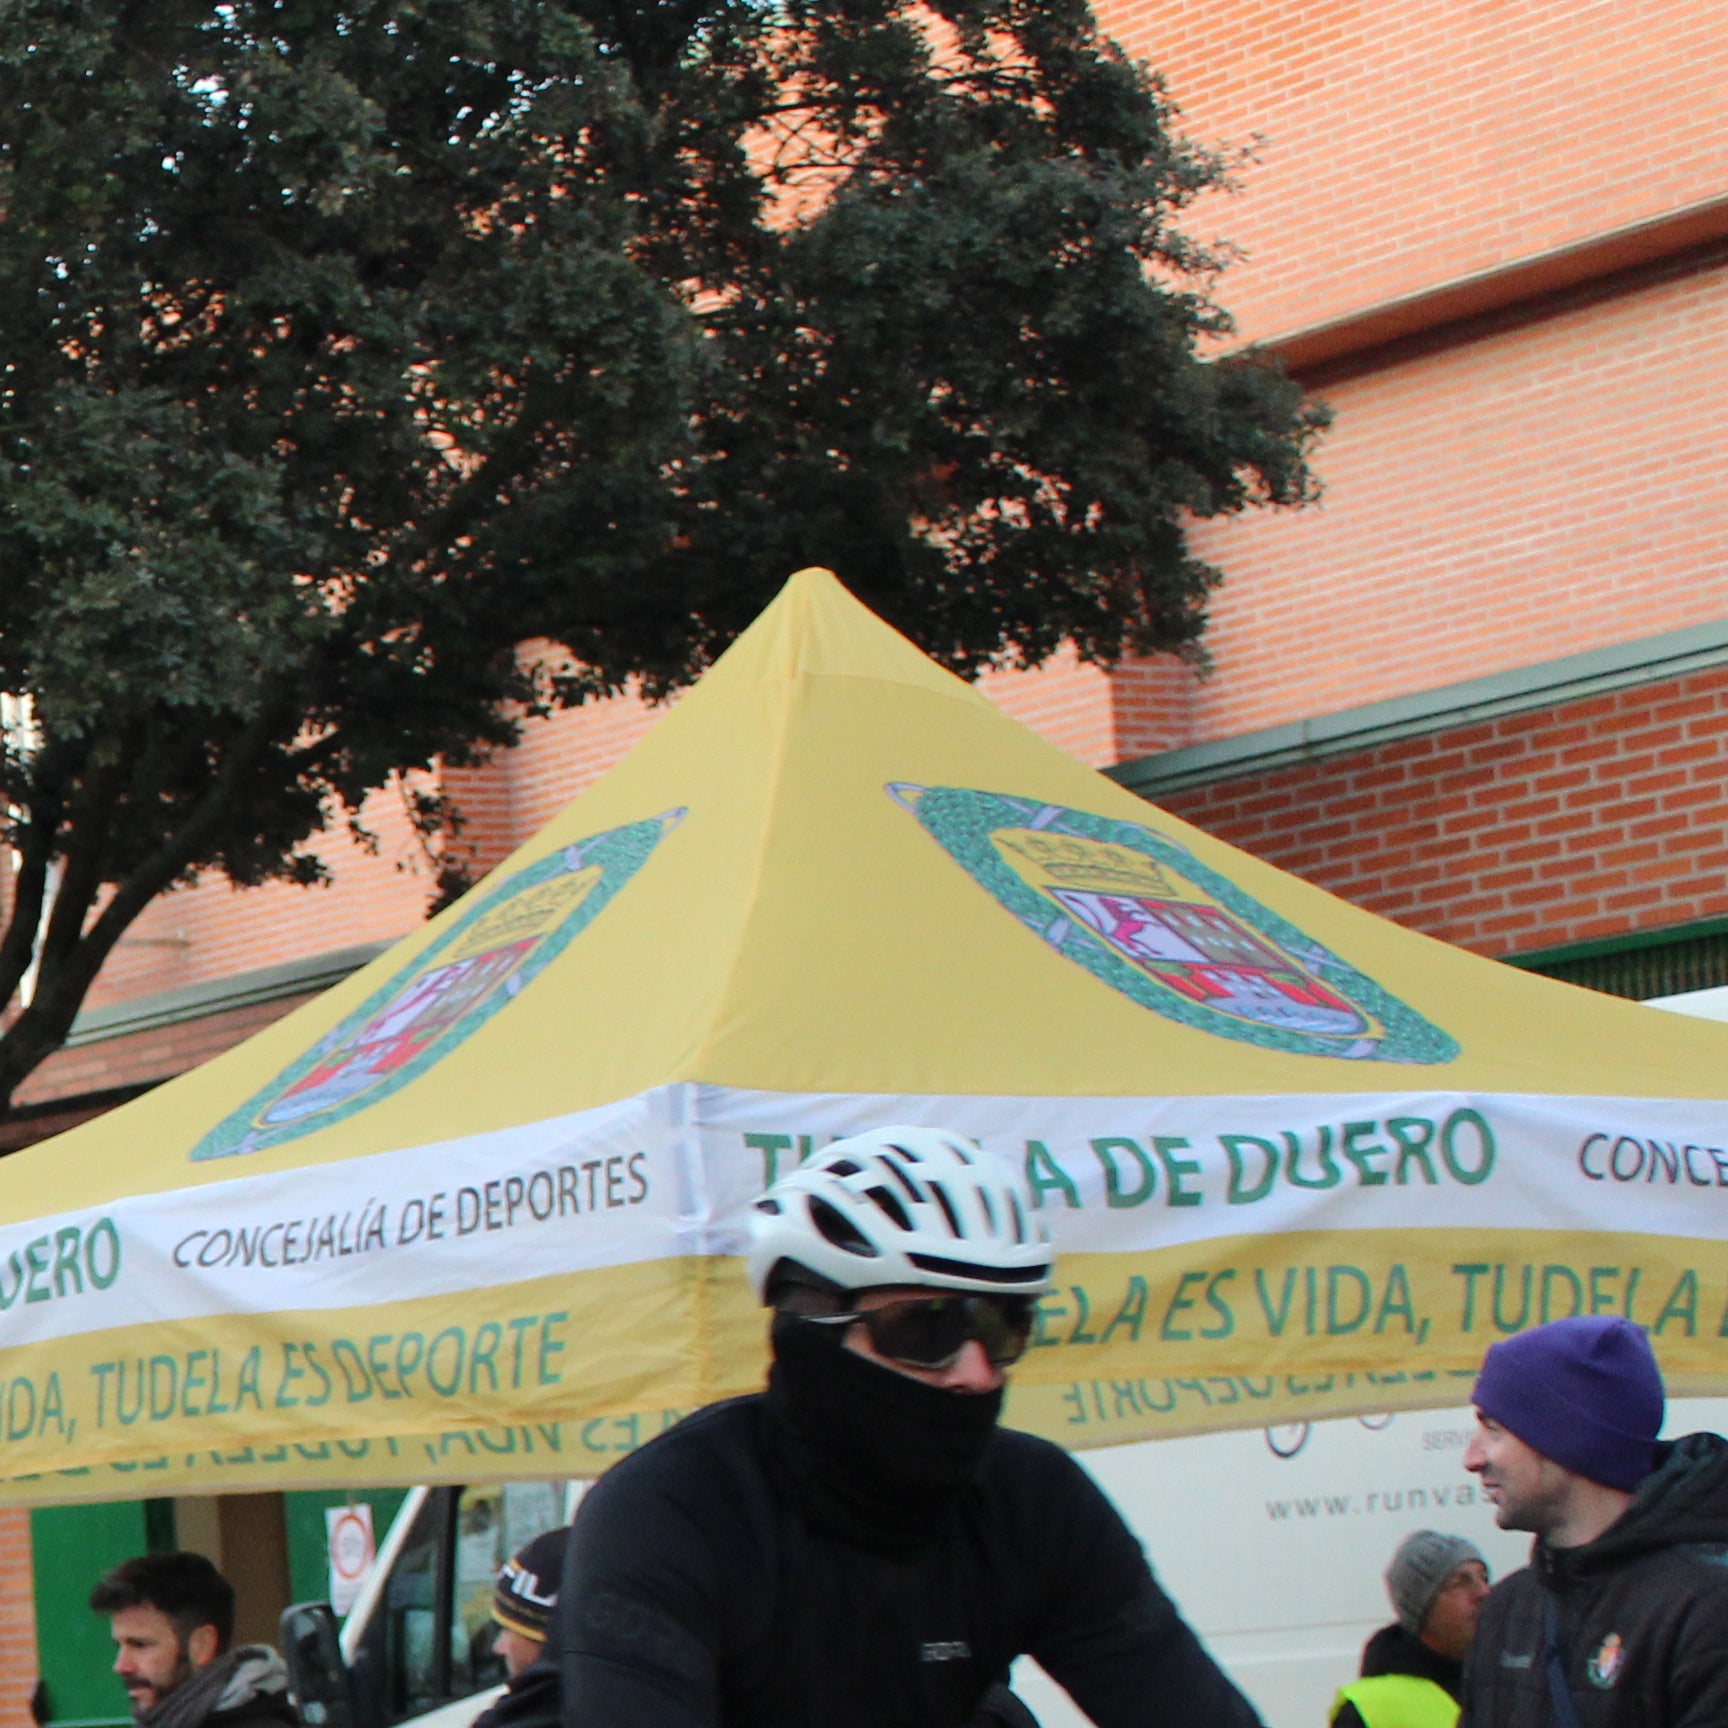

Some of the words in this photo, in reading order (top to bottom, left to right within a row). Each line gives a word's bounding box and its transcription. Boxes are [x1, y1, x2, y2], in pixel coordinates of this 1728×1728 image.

[170, 1197, 385, 1269] CONCEJALÍA
[396, 1191, 448, 1246] DE
[455, 1150, 649, 1238] DEPORTES
[1090, 1135, 1204, 1209] DE
[1218, 1105, 1496, 1208] DUERO
[1577, 1132, 1728, 1187] CONCE
[1160, 1266, 1240, 1343] ES
[1253, 1262, 1433, 1352] VIDA,
[1452, 1263, 1701, 1338] TUDELA
[90, 1345, 263, 1431] TUDELA
[274, 1341, 333, 1408] ES
[332, 1309, 569, 1402] DEPORTE
